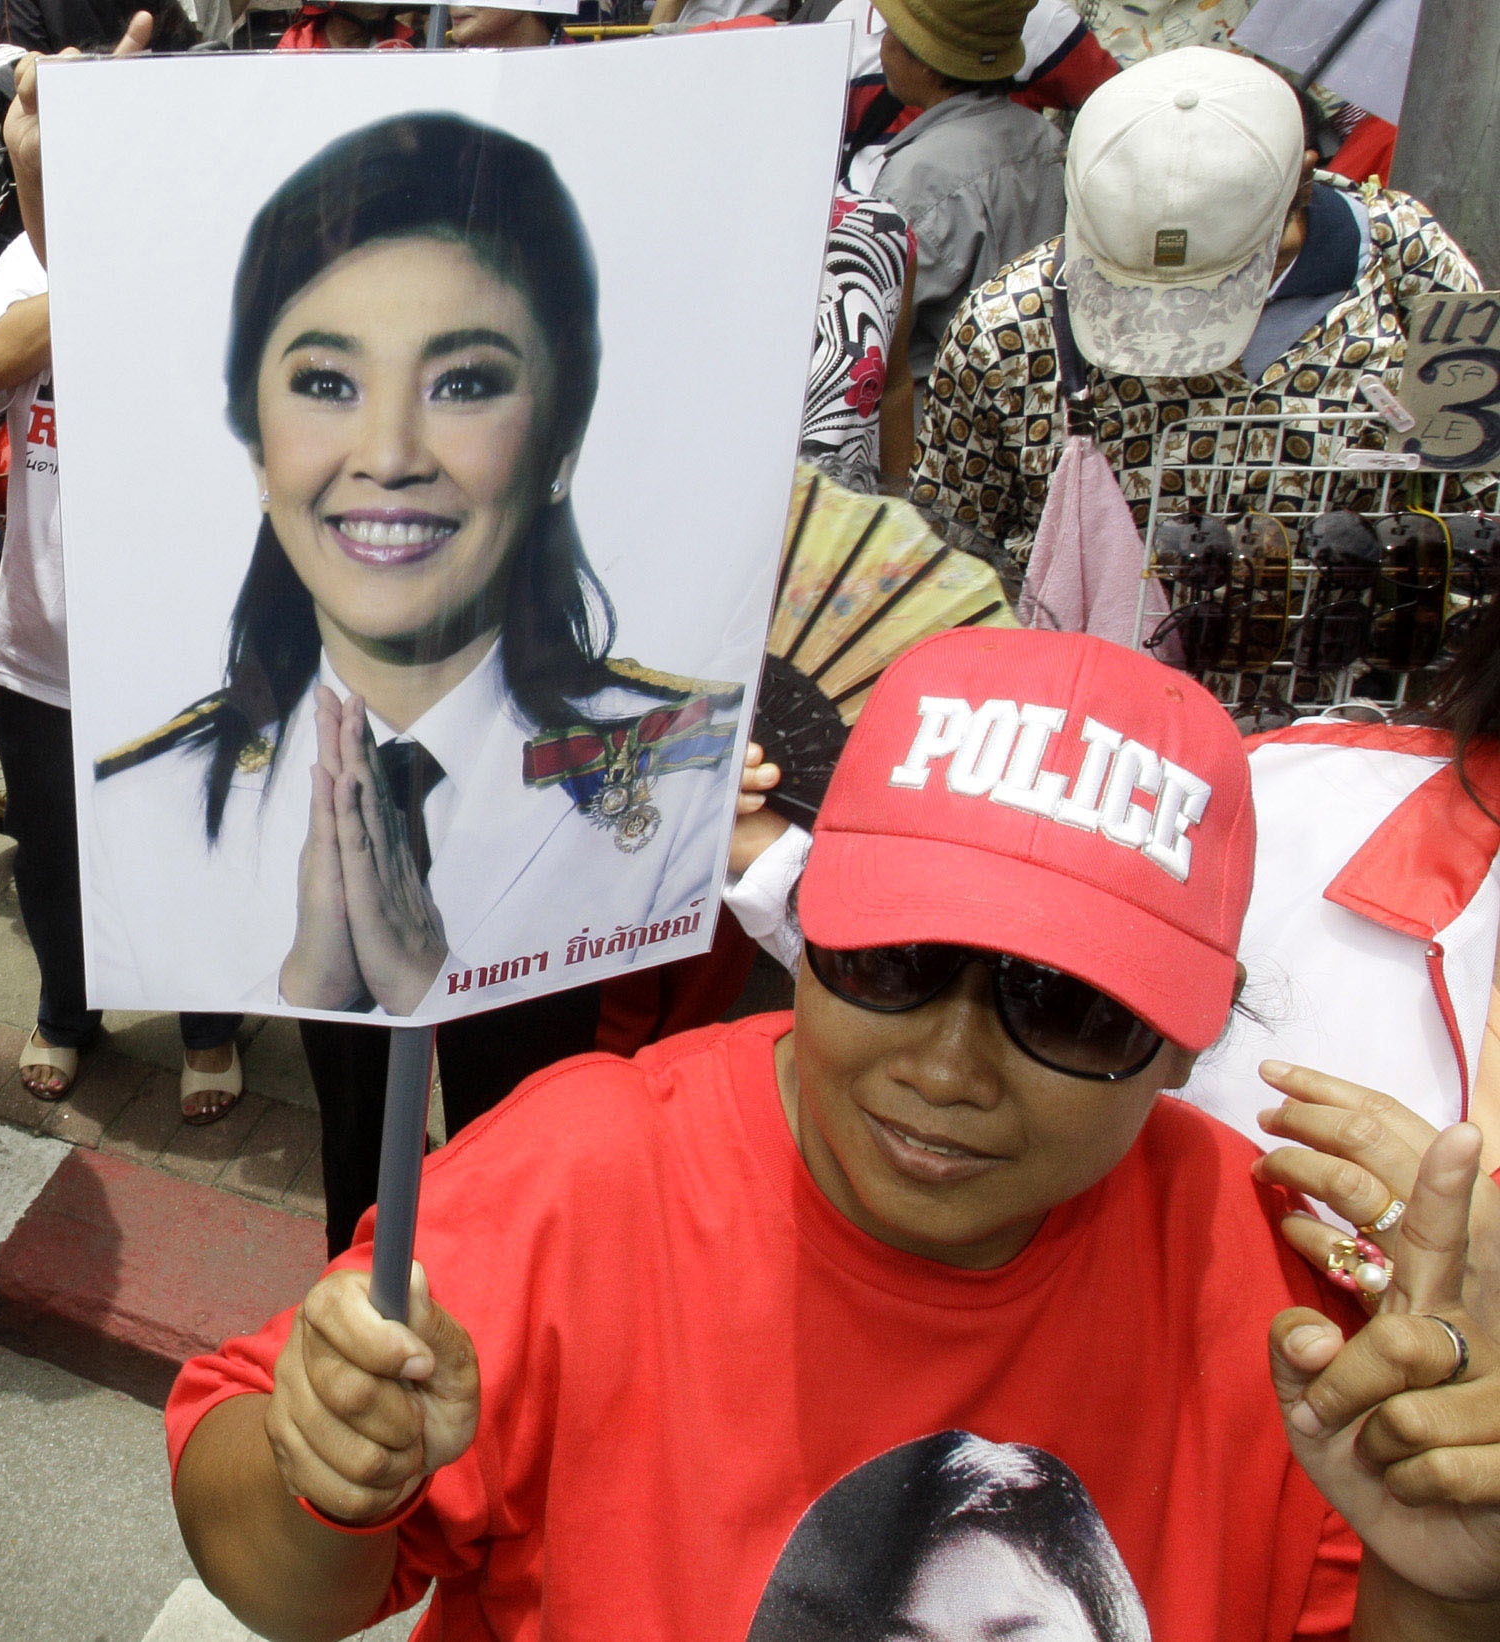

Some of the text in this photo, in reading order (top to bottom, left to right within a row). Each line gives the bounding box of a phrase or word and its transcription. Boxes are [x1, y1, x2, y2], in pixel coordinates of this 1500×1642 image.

[887, 695, 1213, 883] POLICE
[446, 896, 706, 995] นายกฯ ยิ่งลักษณ์
